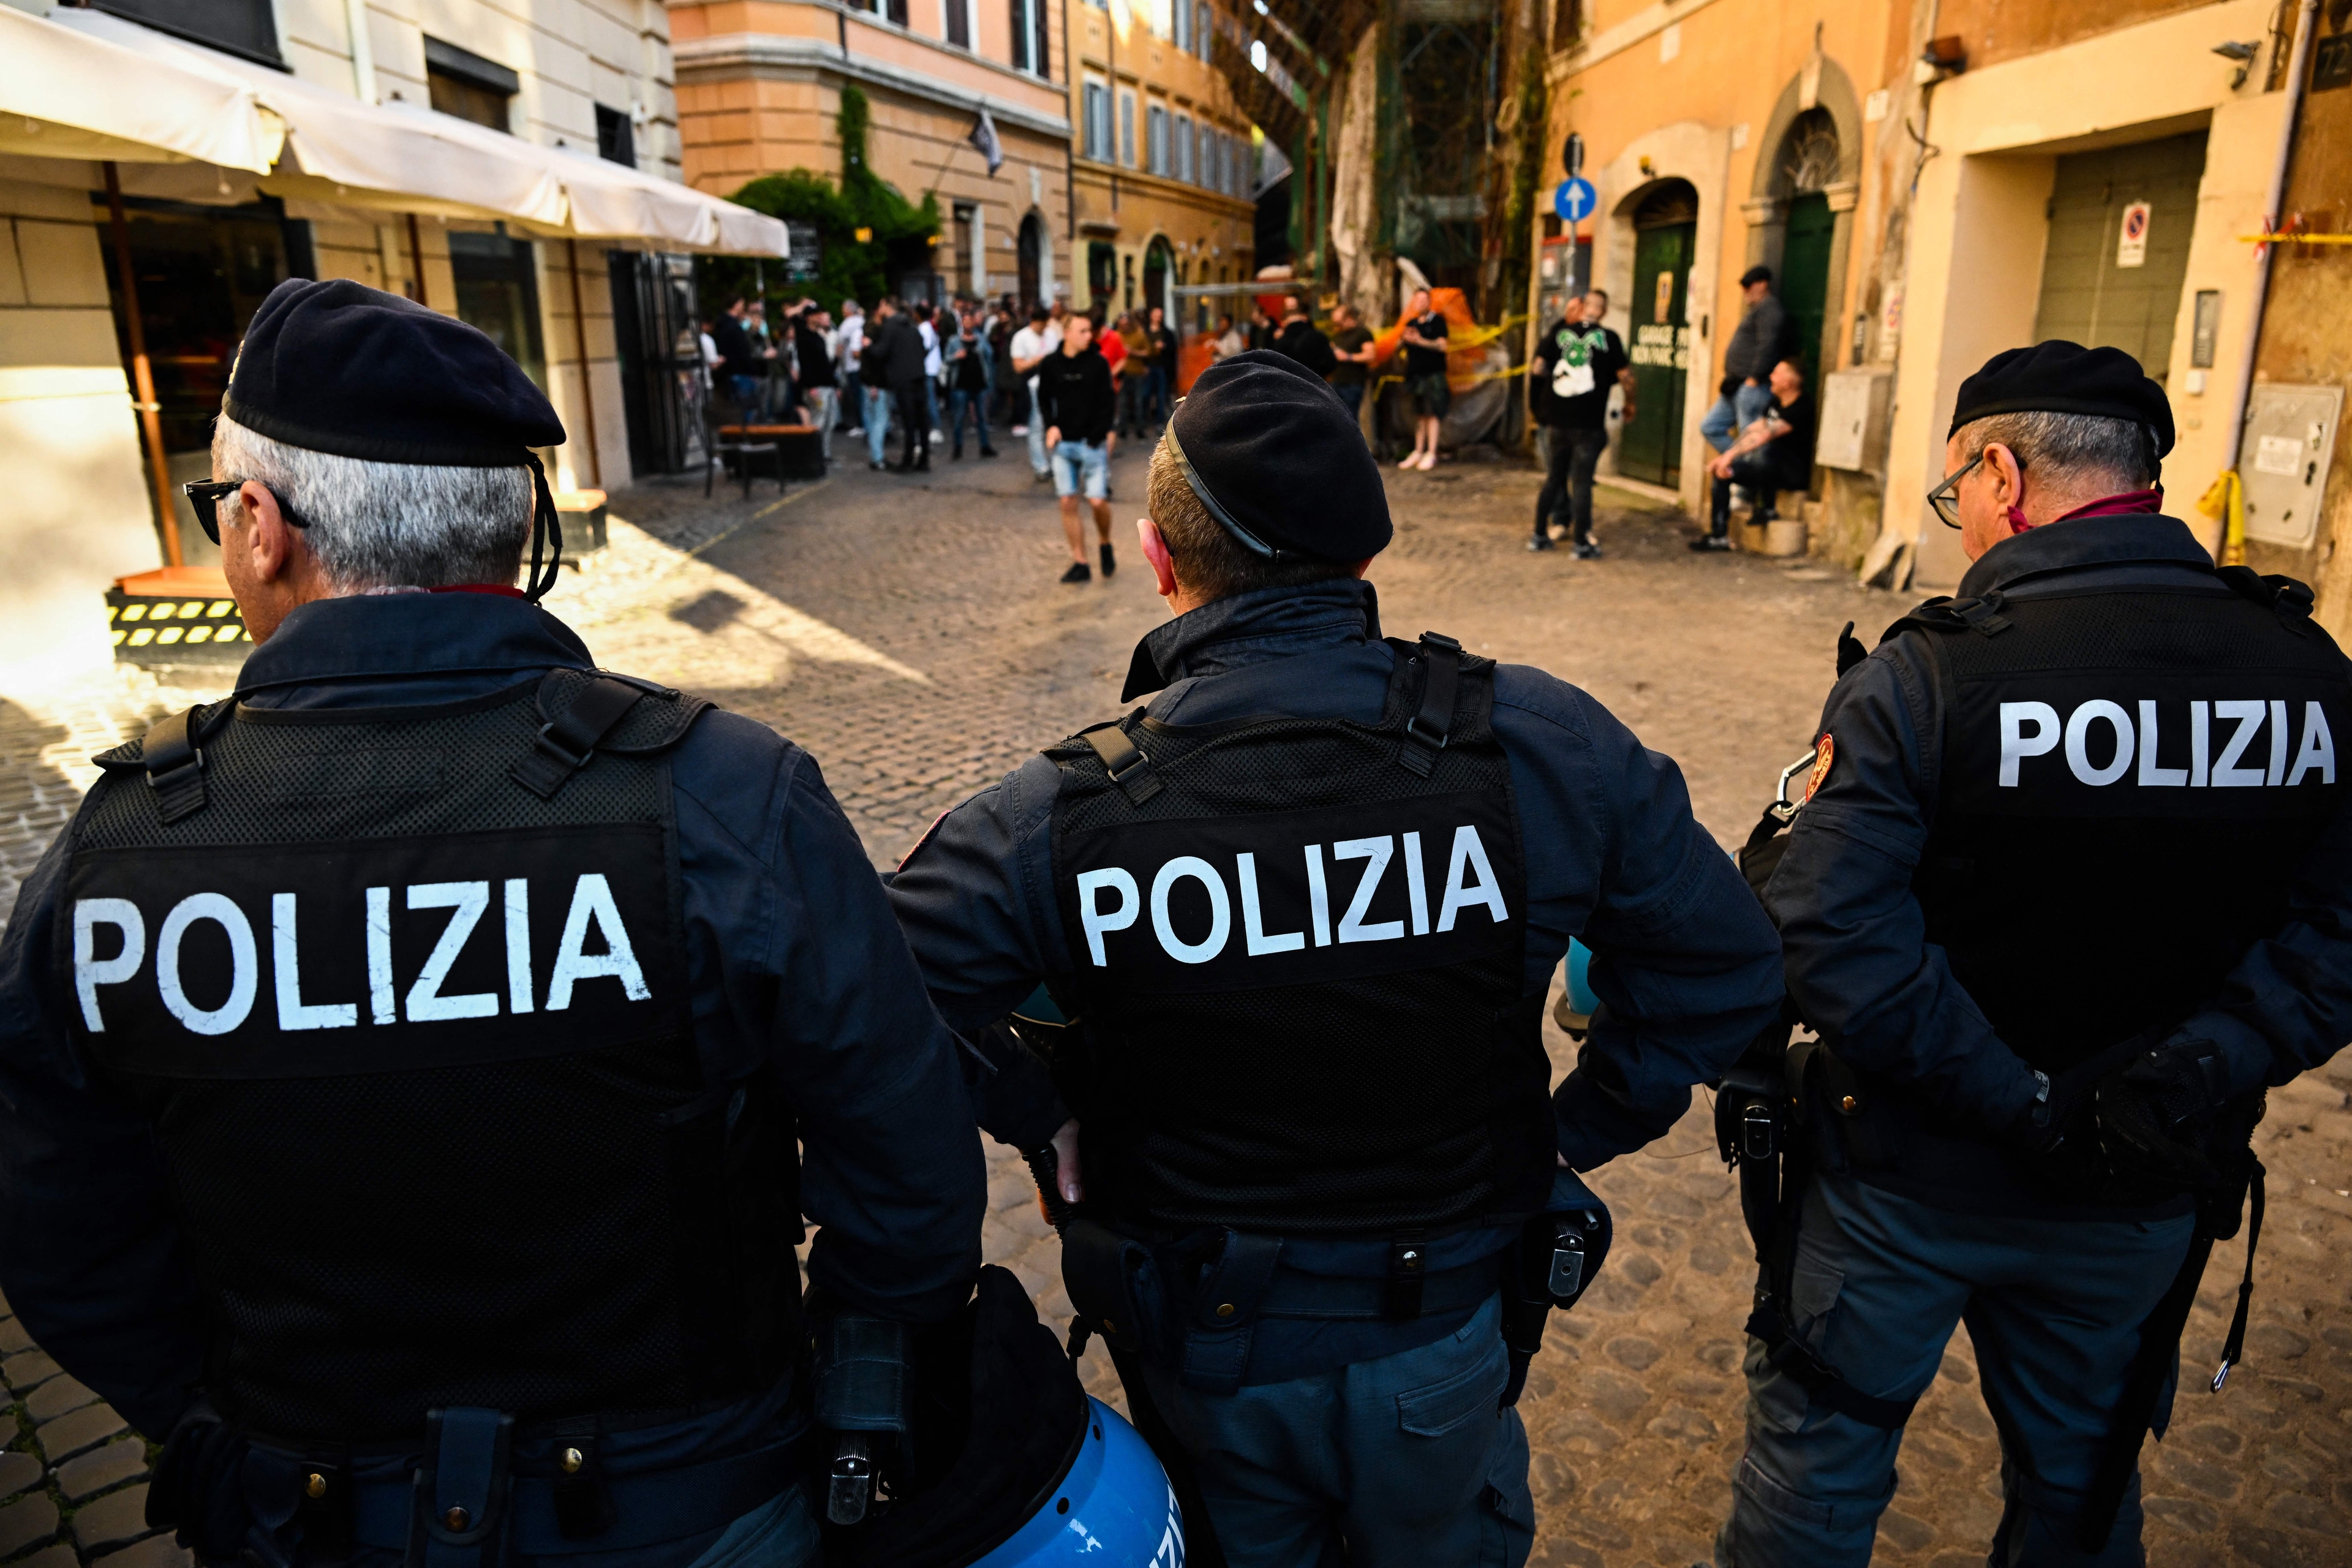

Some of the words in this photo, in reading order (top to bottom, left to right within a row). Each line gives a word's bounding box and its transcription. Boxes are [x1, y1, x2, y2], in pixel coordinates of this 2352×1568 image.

[1999, 699, 2335, 787] POLIZIA
[74, 873, 652, 1035] POLIZIA
[1077, 824, 1509, 967] POLIZIA
